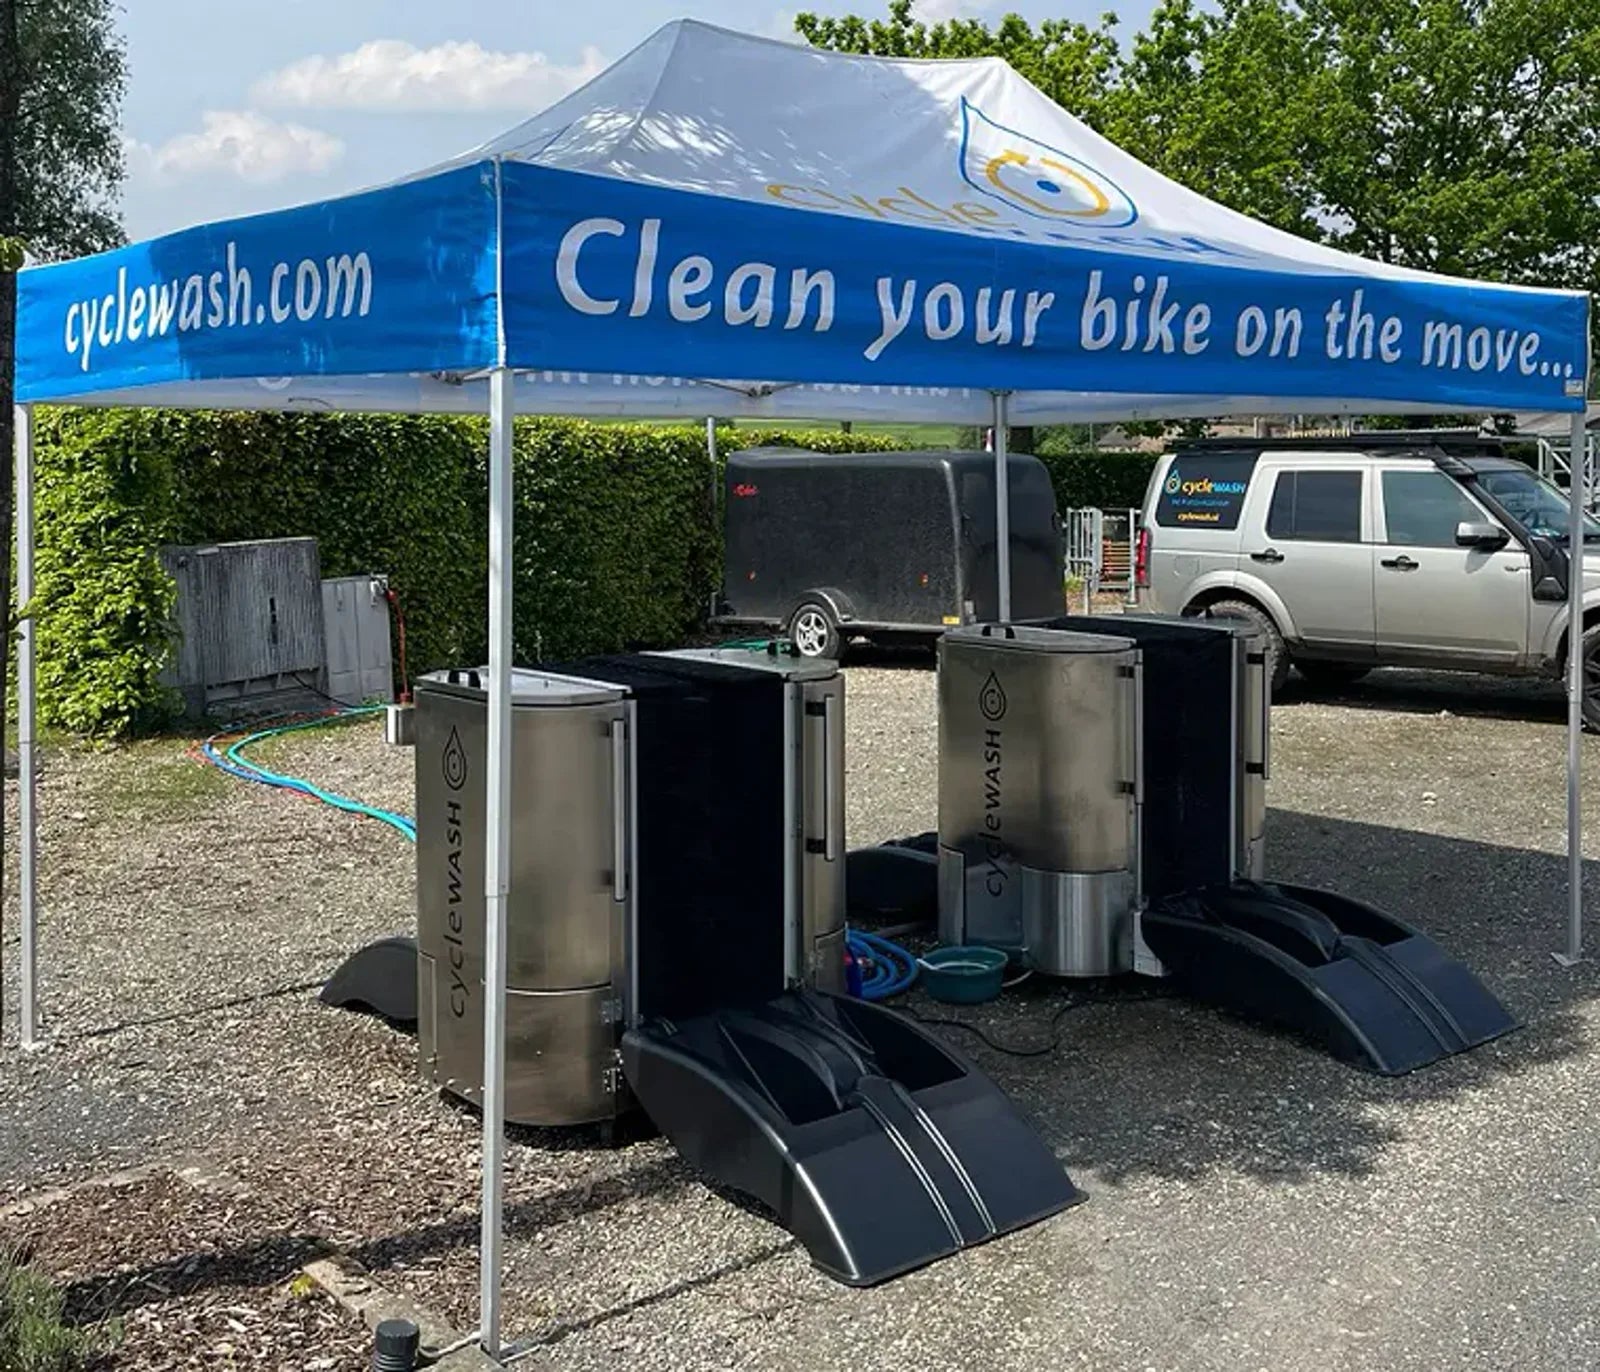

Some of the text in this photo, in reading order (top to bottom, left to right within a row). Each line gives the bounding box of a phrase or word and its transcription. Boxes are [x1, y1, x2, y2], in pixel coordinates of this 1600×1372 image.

[65, 242, 373, 371] cyclewash.com
[555, 217, 1573, 379] Clean your bike on the move...
[978, 728, 1009, 897] cycleWASH
[443, 801, 468, 1019] cycleWASH
